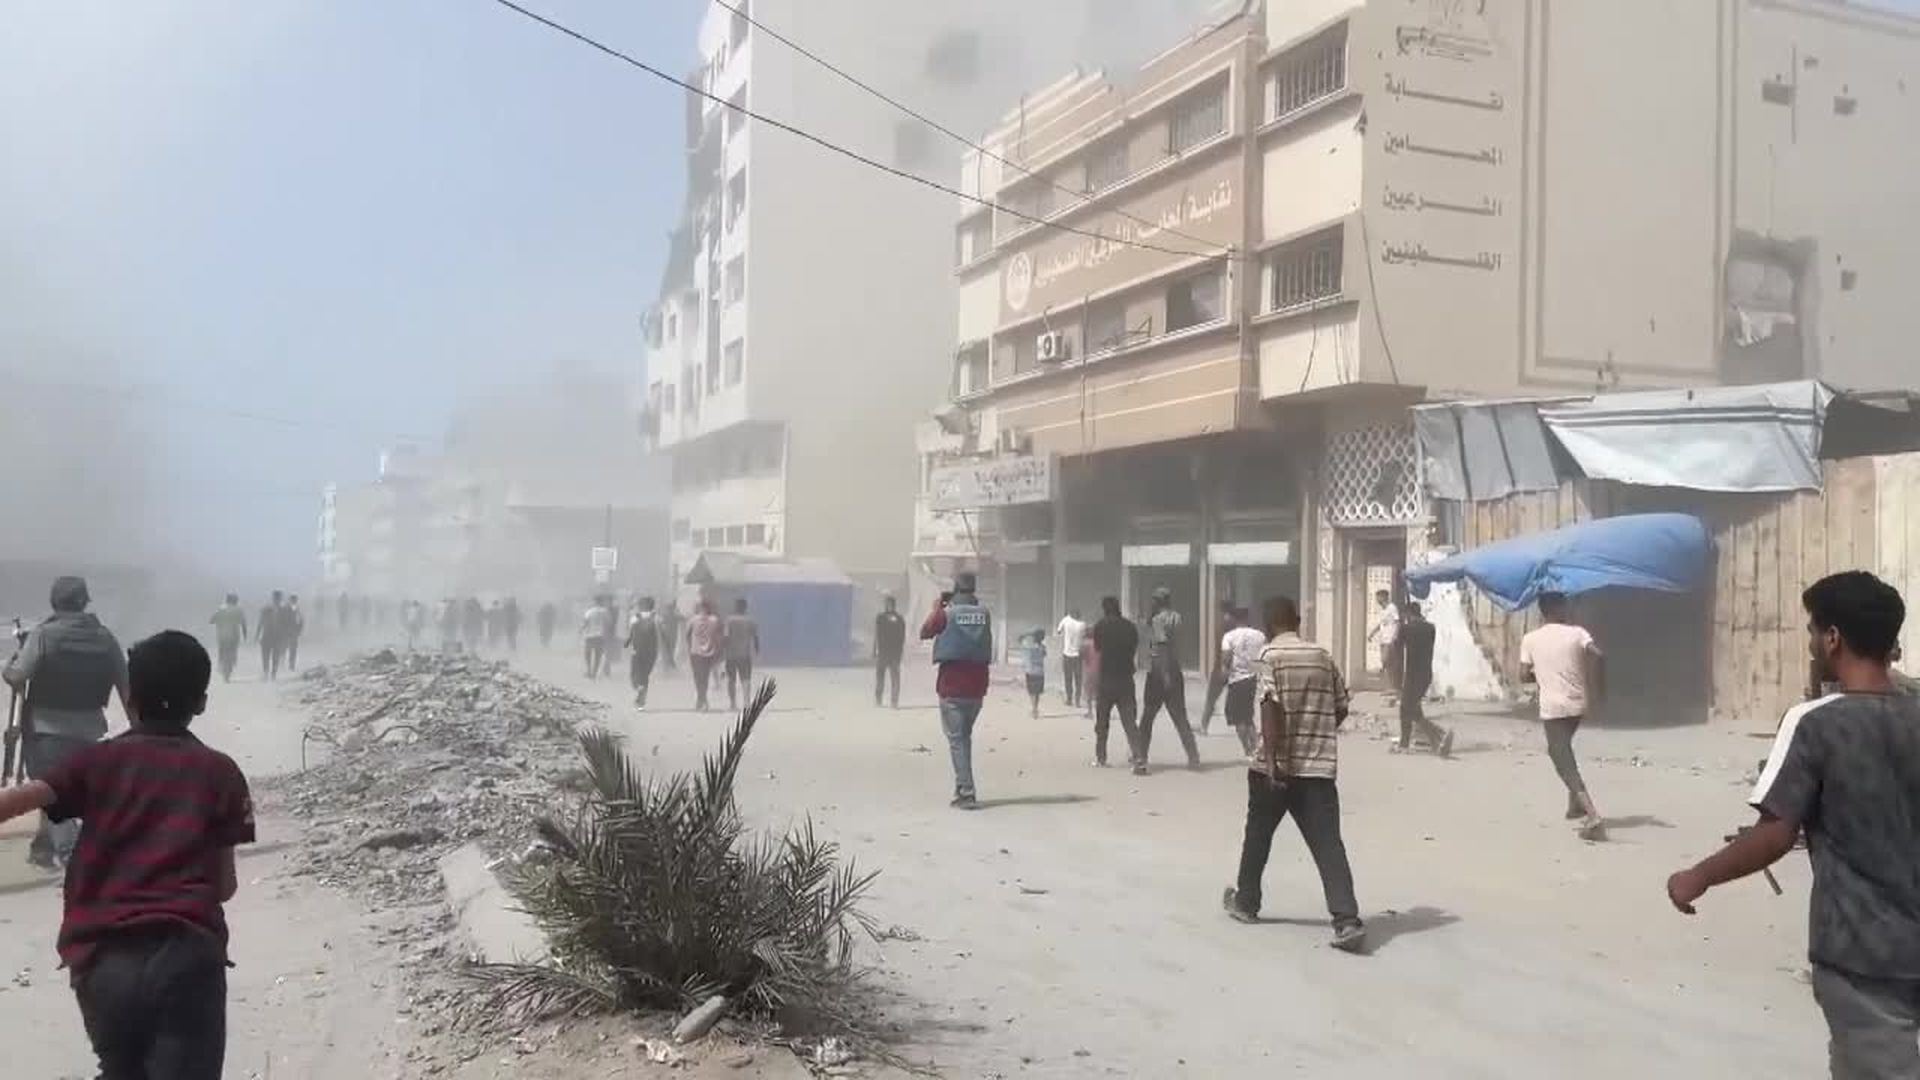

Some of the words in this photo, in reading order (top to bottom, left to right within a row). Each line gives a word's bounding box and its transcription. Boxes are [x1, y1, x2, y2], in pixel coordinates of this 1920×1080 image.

[1384, 71, 1504, 111] نقابة
[1383, 130, 1503, 166] المحامين
[1382, 183, 1502, 217] الشرعيين
[1381, 239, 1501, 271] الفلسطينيين
[956, 612, 986, 625] PRESS
